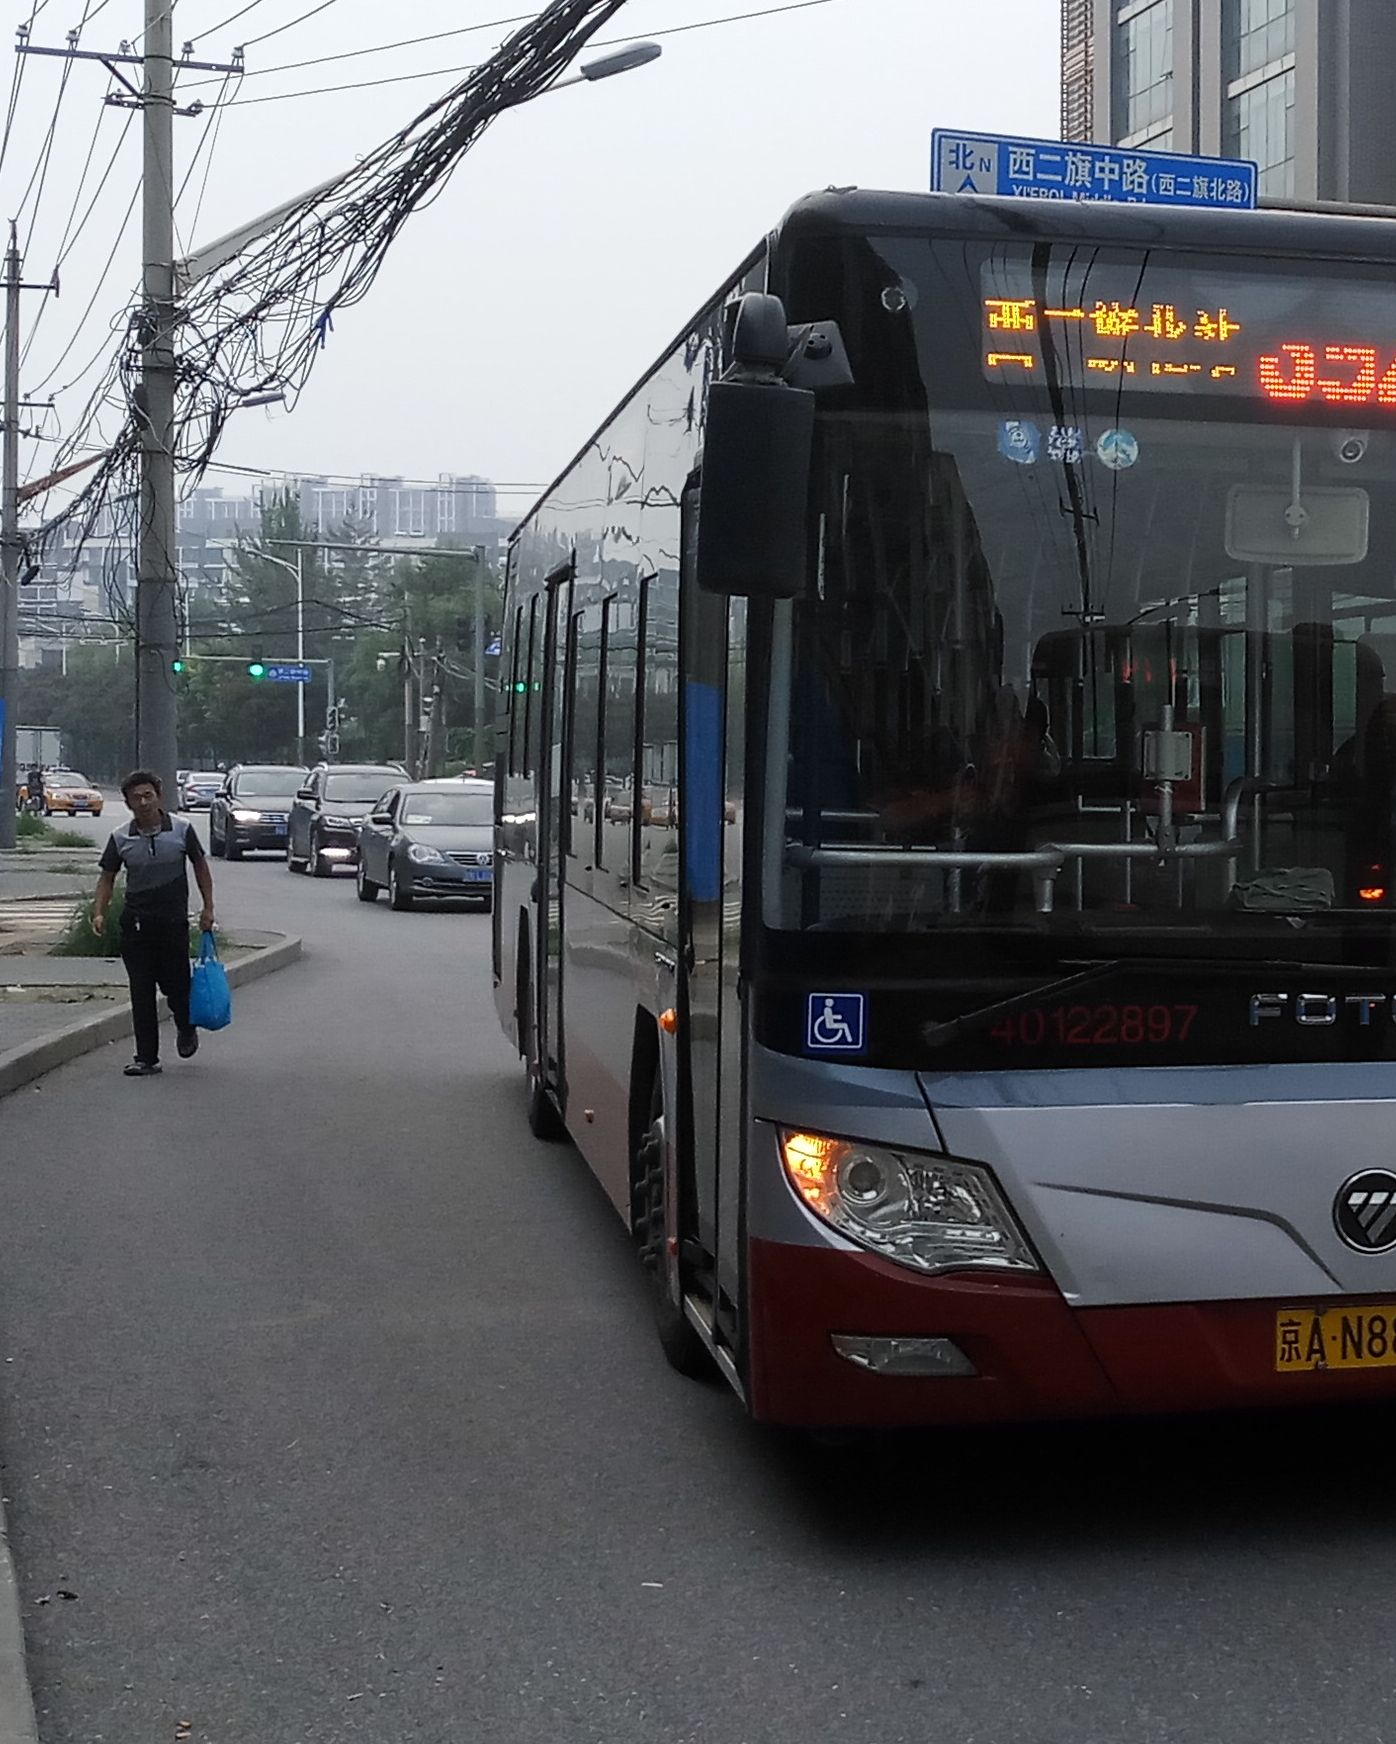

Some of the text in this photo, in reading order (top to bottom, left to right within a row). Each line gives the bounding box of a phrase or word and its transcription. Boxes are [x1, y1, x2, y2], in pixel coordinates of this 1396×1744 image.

[949, 142, 992, 173] 北 N
[1008, 146, 1149, 194] 西二旗中路
[990, 1004, 1200, 1045] 40122897
